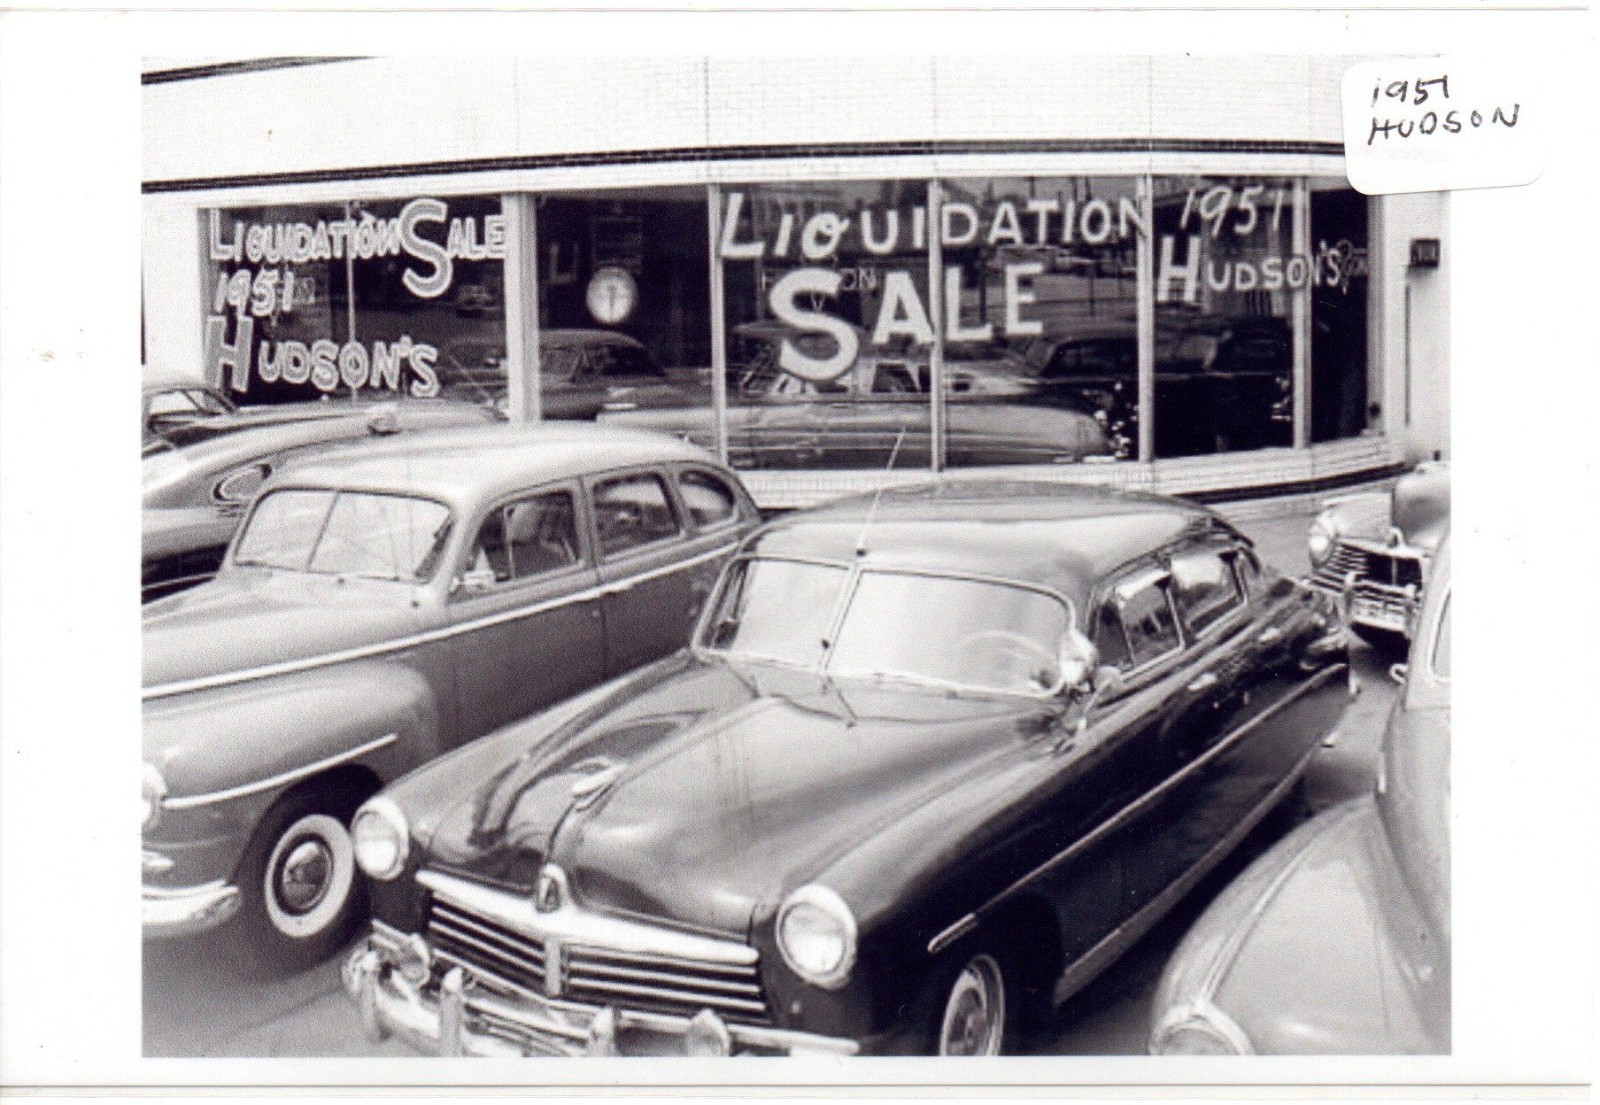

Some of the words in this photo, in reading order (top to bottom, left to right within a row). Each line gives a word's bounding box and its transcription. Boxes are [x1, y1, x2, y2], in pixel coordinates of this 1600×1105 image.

[1367, 103, 1520, 146] HUDSON
[1180, 185, 1284, 237] 1951
[400, 197, 506, 298] SALE
[213, 269, 294, 318] 1951
[769, 262, 1044, 381] SALE
[204, 315, 440, 398] HUDSON'S
